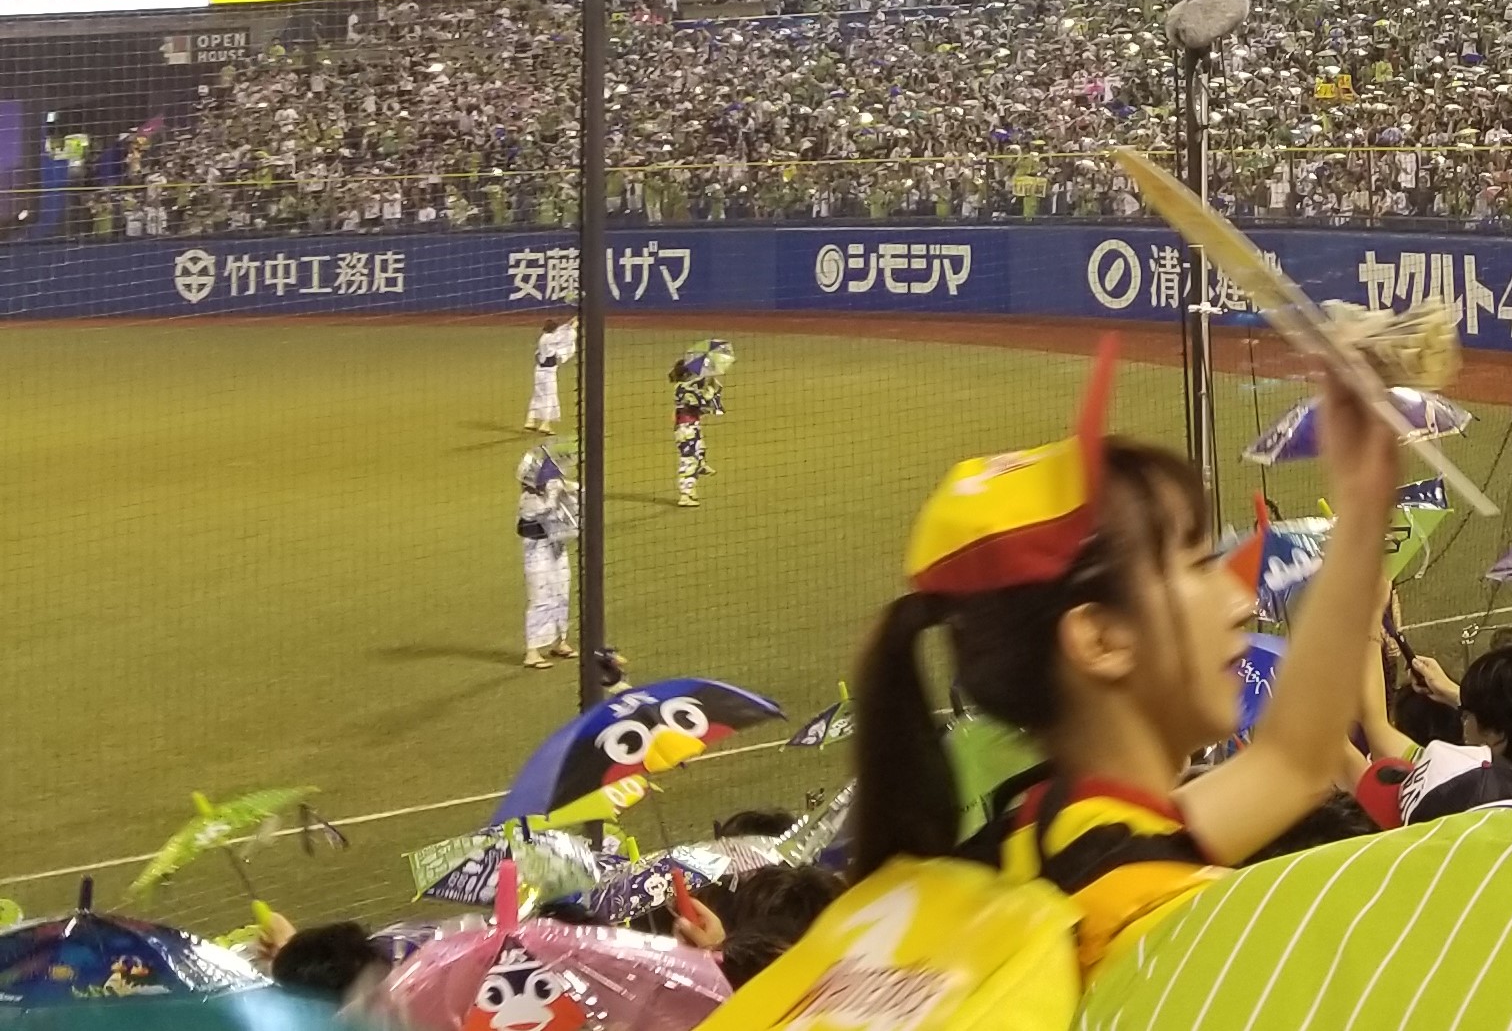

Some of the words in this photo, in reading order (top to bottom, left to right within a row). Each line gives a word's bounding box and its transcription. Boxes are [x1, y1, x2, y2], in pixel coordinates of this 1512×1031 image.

[197, 32, 246, 48] OPEN
[223, 251, 406, 297] 竹中工務店
[847, 243, 972, 296] シモジマ
